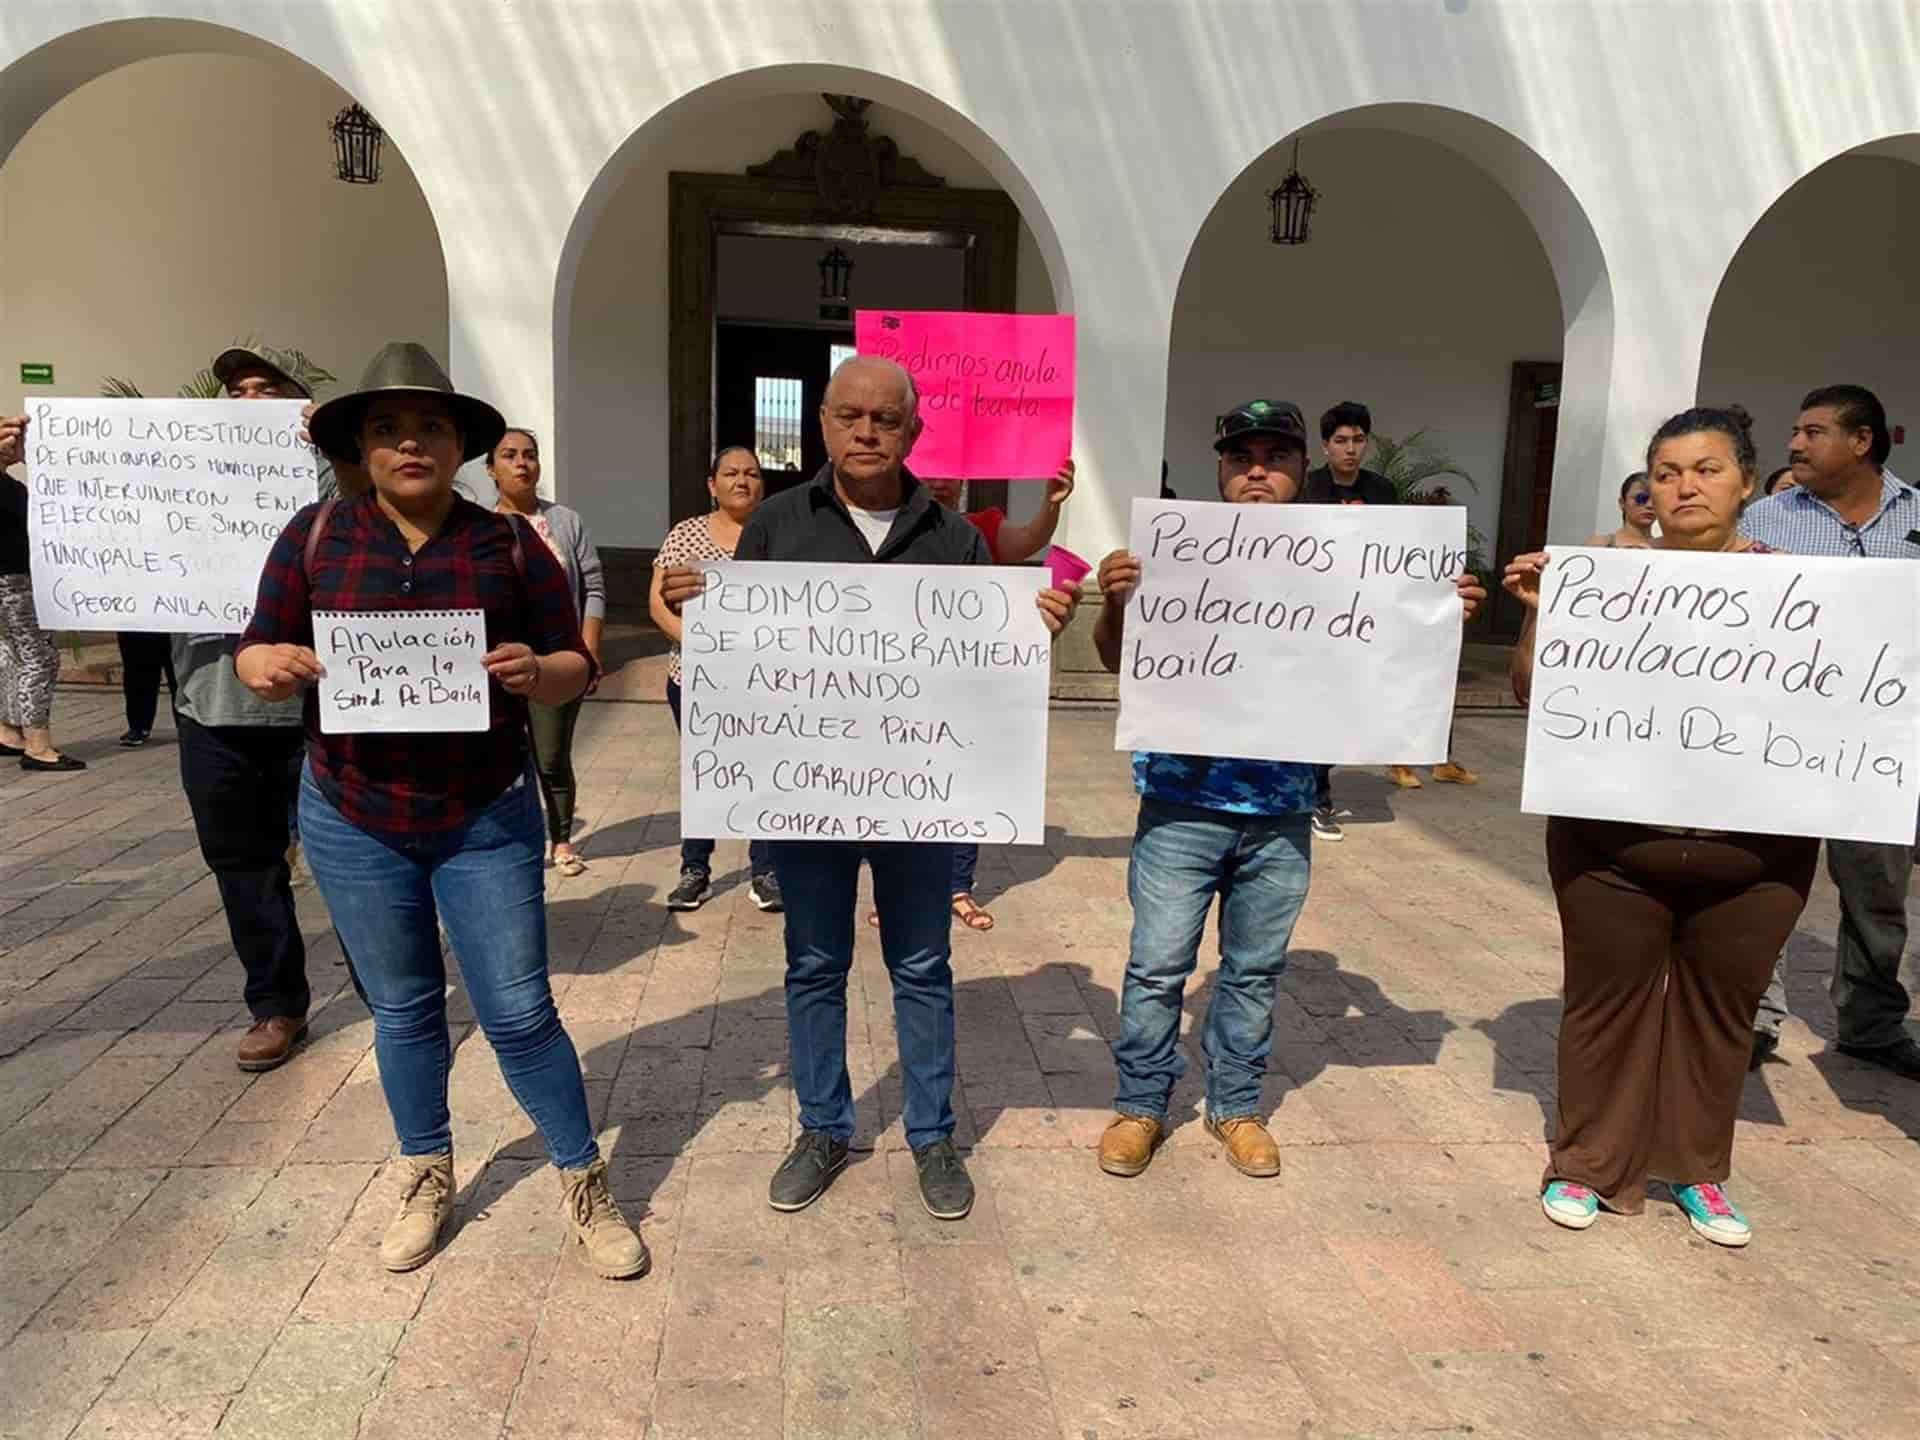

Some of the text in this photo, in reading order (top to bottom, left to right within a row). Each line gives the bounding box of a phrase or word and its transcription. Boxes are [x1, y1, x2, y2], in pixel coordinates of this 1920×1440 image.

[37, 403, 112, 440] PEDIMO
[36, 445, 57, 465] DE
[66, 446, 196, 470] FUNCIONARIOS
[35, 473, 66, 496] QUE
[78, 477, 228, 506] INTERVINIERON
[167, 511, 200, 537] DE
[1150, 511, 1336, 572] Pedimos
[53, 578, 136, 616] (PEDRO
[154, 595, 216, 618] AVILA
[701, 568, 873, 618] PEDIMOS
[1548, 554, 1820, 631] Pedimos la
[1328, 591, 1375, 642] de
[331, 626, 475, 655] Anulación
[689, 622, 740, 653] SE
[347, 654, 453, 684] Para la
[747, 664, 920, 701] ARMANDO
[421, 676, 482, 704] Baila
[1542, 685, 1903, 787] Sind. De baila
[692, 750, 953, 801] POR CORRUPCIÓN
[856, 816, 889, 840] DE
